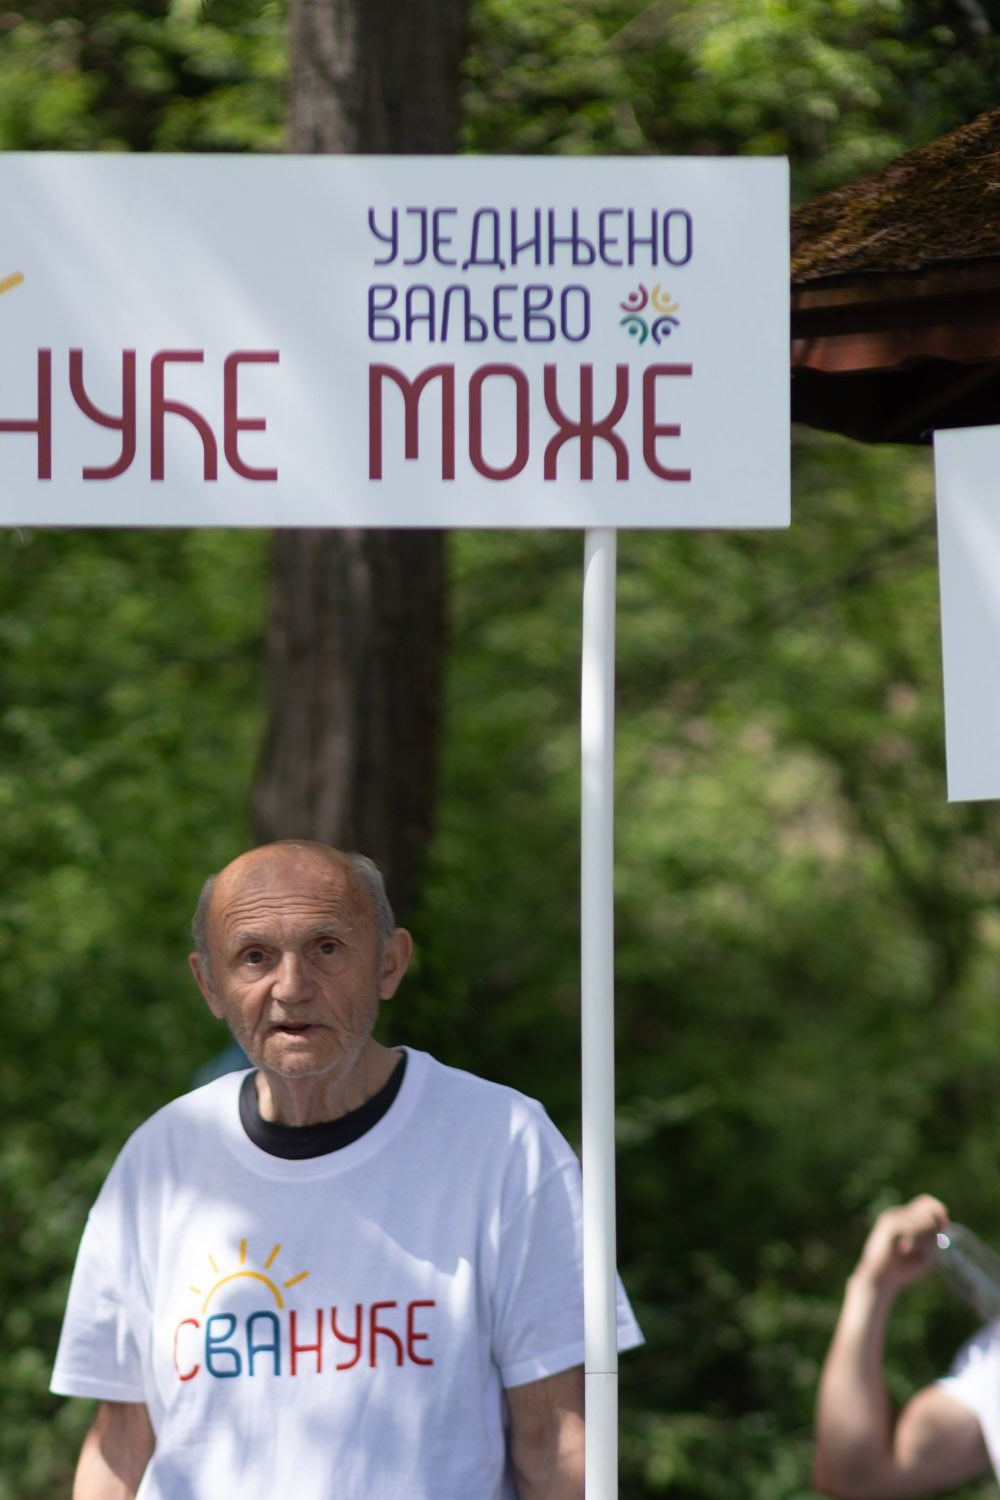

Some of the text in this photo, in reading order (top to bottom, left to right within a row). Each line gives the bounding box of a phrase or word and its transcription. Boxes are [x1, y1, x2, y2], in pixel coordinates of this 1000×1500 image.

[367, 206, 694, 271] УЈЕДИЊЕНО
[367, 284, 591, 343] ВАЉЕВО
[368, 362, 694, 483] МОЖЕ
[173, 1300, 436, 1382] СВАНУЋЕ
